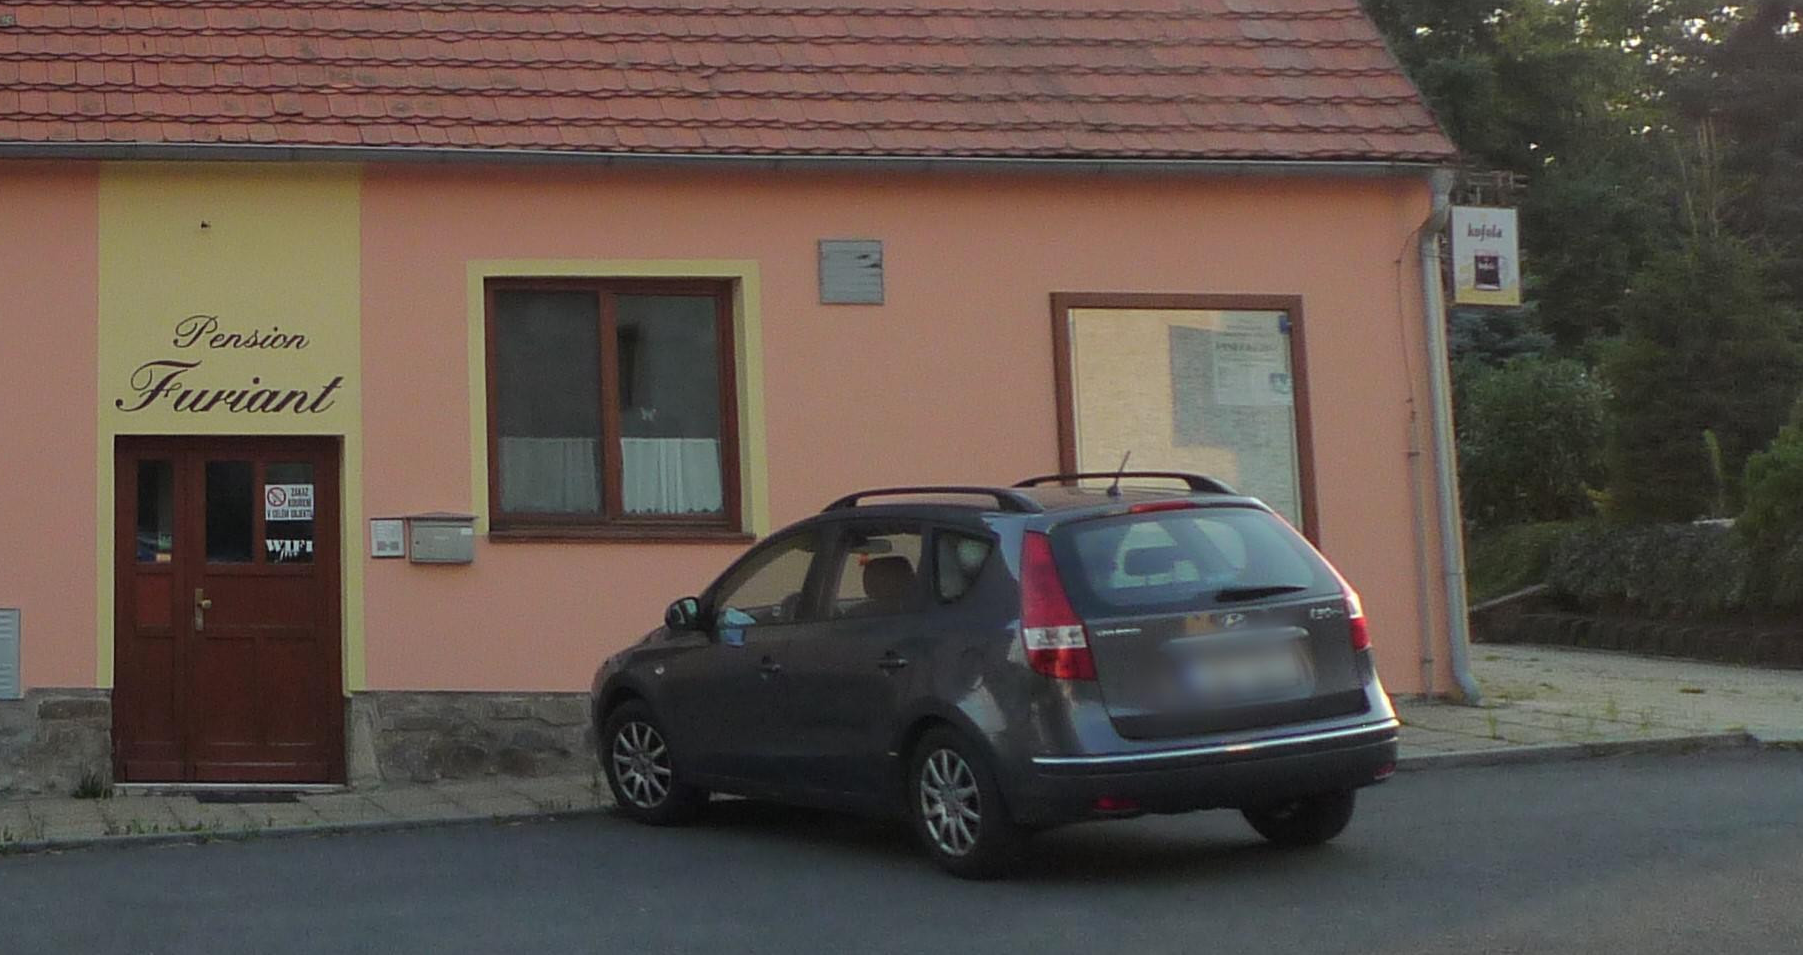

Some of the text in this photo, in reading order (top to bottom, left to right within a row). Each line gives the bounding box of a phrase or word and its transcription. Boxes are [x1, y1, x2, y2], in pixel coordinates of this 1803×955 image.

[1467, 222, 1503, 242] kofola
[173, 314, 310, 349] Pension
[115, 360, 344, 414] Furiant
